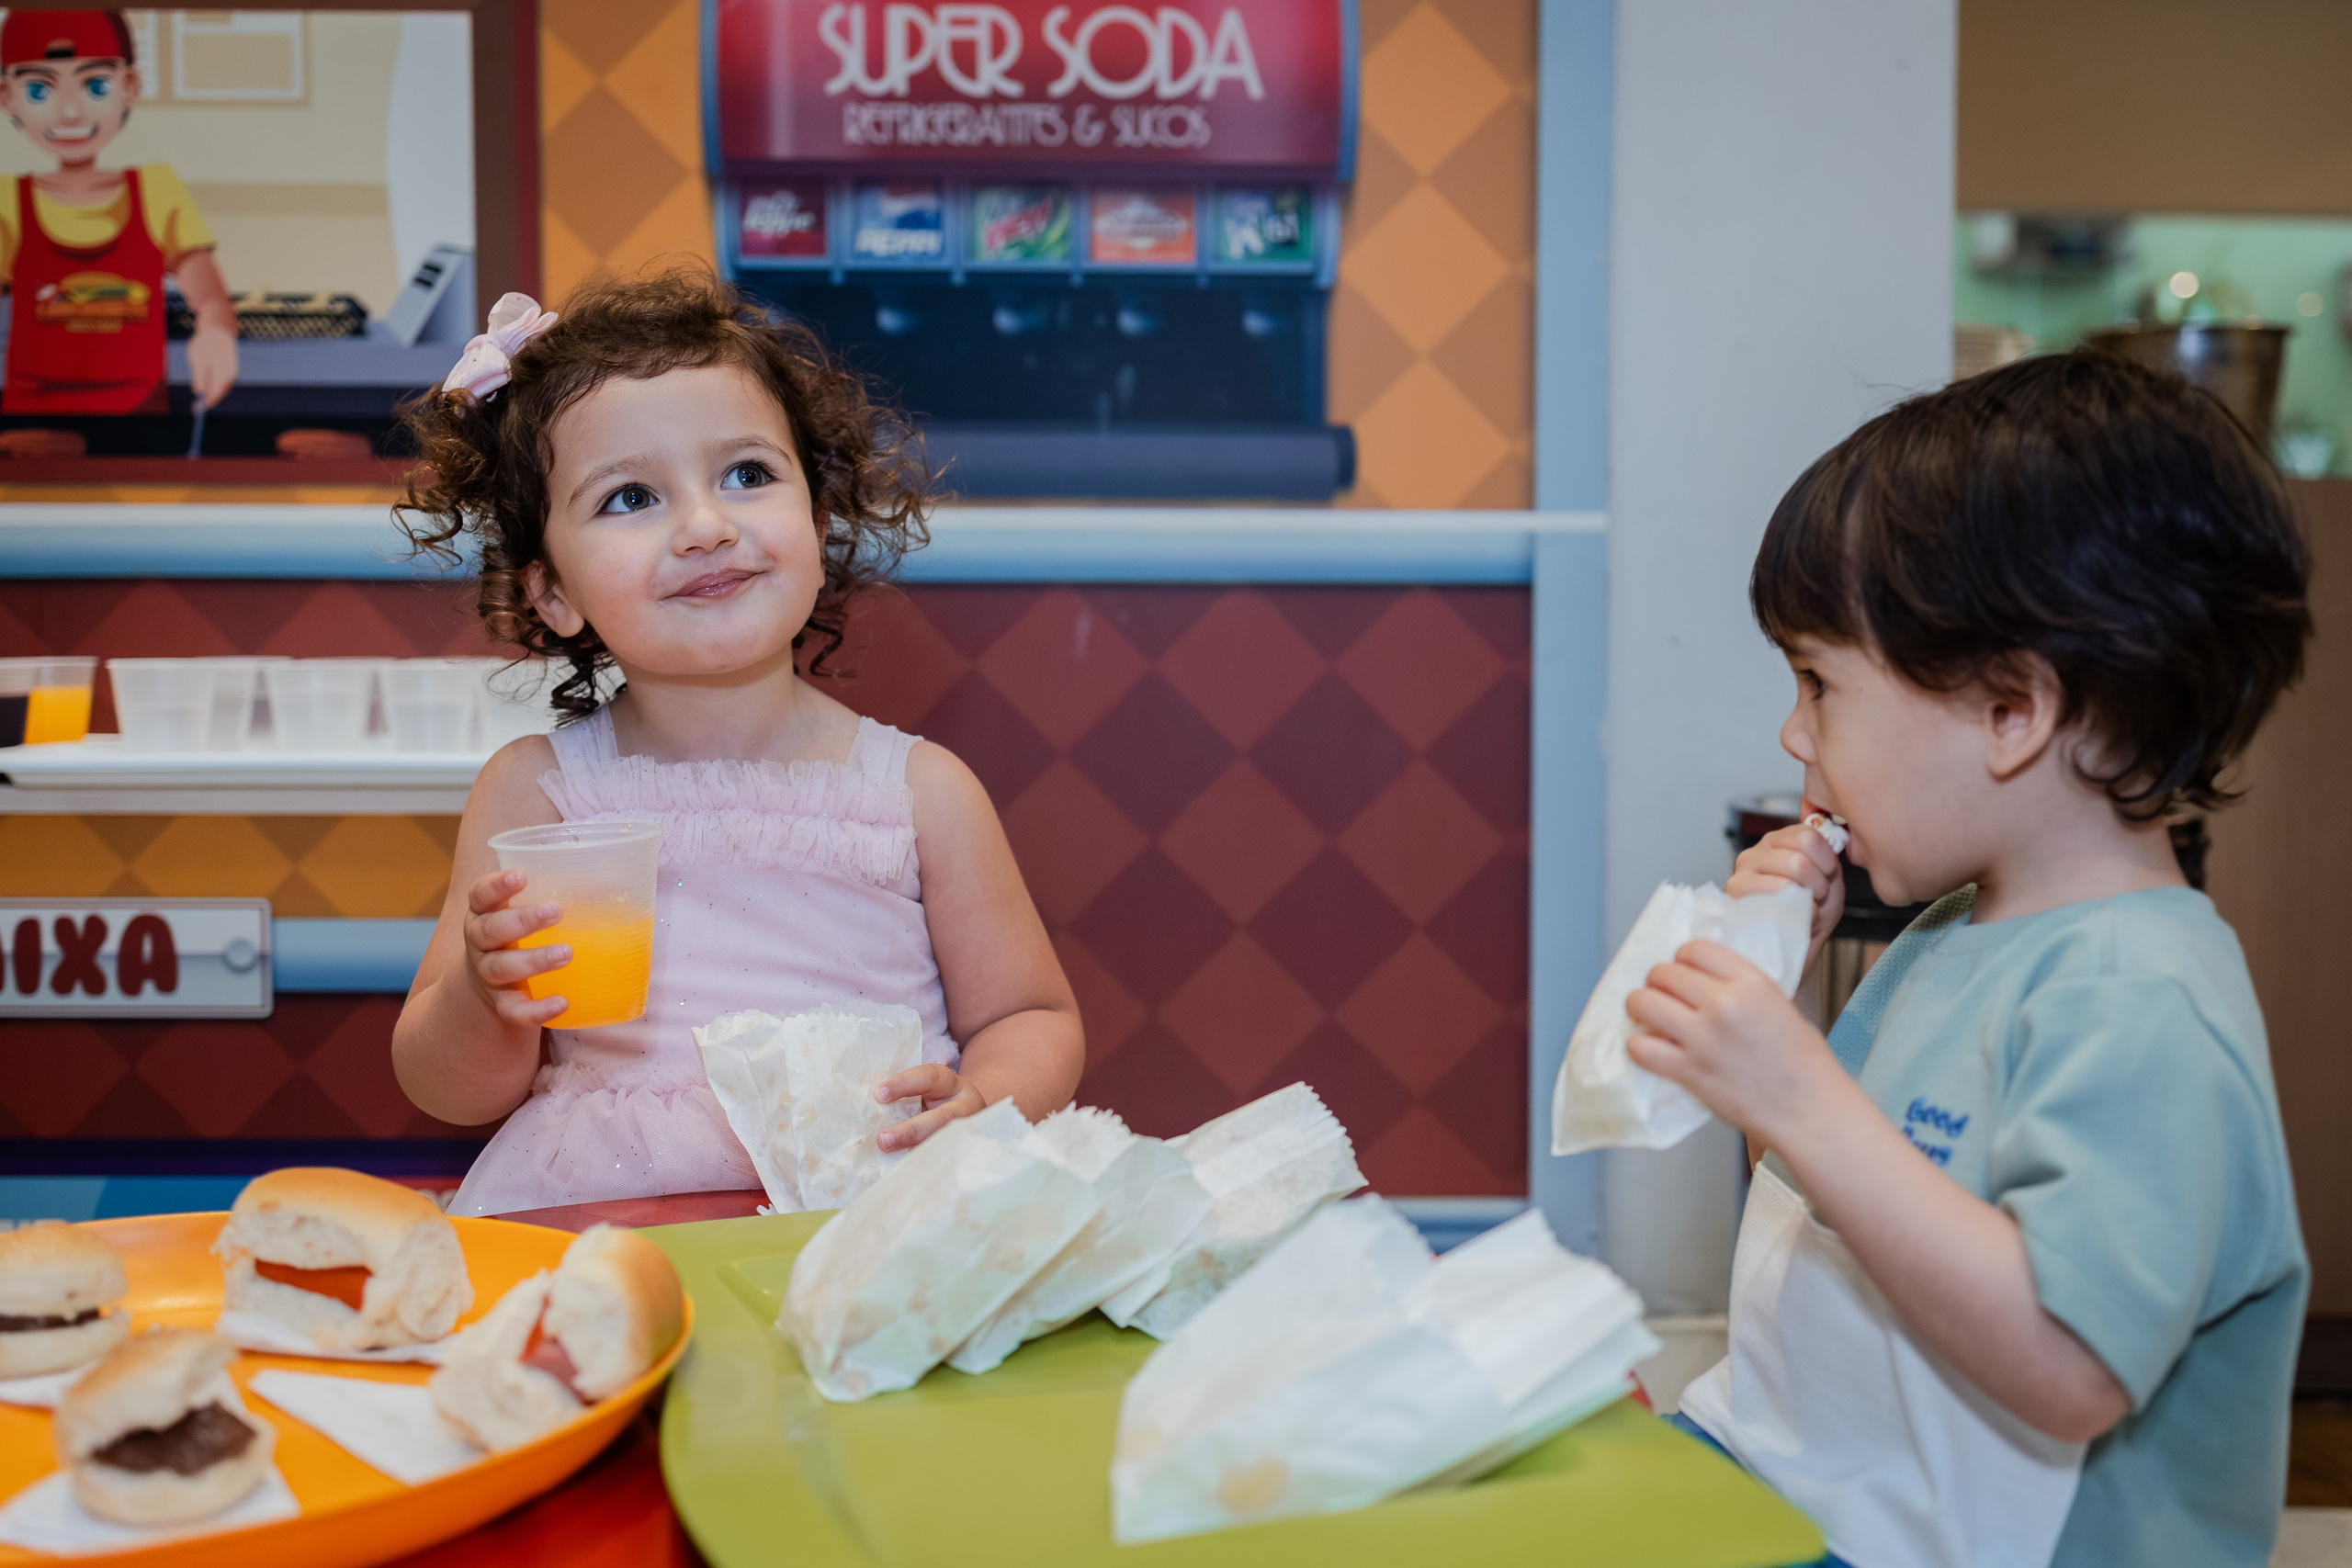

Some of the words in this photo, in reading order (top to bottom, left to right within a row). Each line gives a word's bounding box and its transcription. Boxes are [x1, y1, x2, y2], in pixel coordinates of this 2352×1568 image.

[818, 4, 1024, 98] SUPER
[1041, 5, 1264, 100] SODA
[0, 914, 179, 998] IXA
